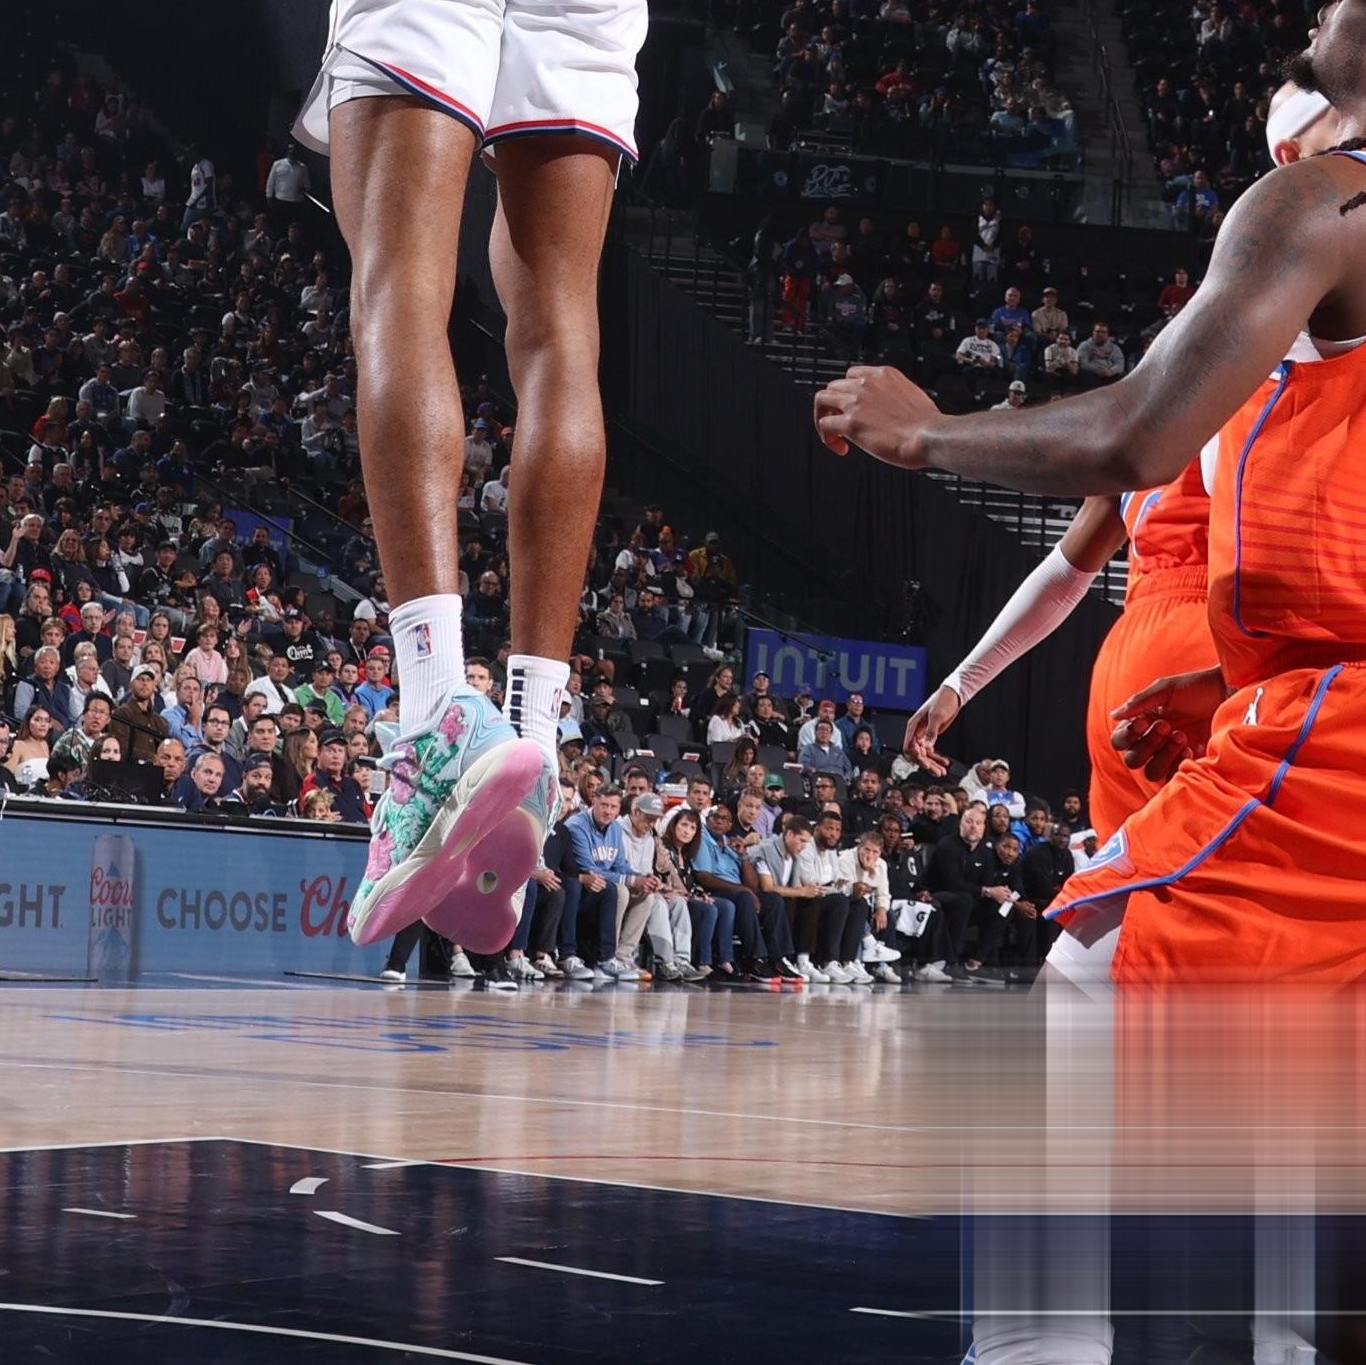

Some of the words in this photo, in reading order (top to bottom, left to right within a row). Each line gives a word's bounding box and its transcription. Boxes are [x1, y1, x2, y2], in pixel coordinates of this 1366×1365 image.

[757, 639, 916, 698] INTUIT
[90, 908, 131, 928] LIGHT
[158, 890, 286, 932] CHOOSE
[301, 875, 347, 936] Ch
